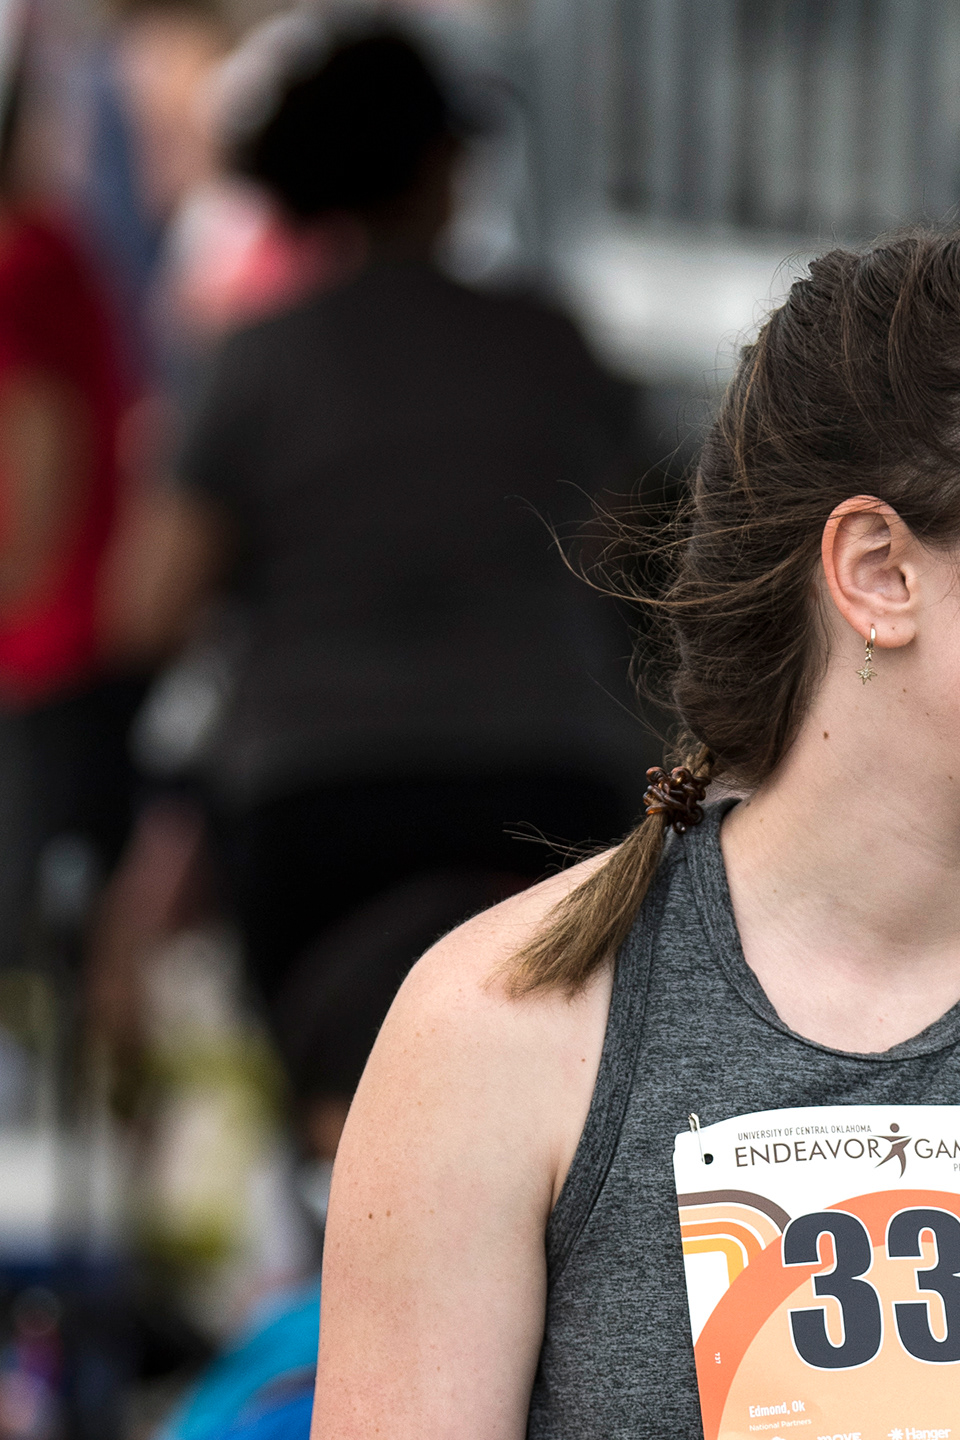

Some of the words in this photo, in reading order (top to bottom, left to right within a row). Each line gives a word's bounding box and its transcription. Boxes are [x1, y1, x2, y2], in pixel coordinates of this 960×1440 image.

[738, 1129, 783, 1141] UNIVERSITY
[784, 1127, 793, 1136] OF
[795, 1125, 829, 1136] CENTRAL
[831, 1124, 872, 1134] OKLAHOMA
[735, 1138, 882, 1168] ENDEAVOR
[749, 1402, 790, 1418] Edmond,
[792, 1400, 806, 1412] Ok
[749, 1421, 780, 1432] National
[781, 1419, 812, 1428] Partners
[905, 1427, 952, 1440] Hanger
